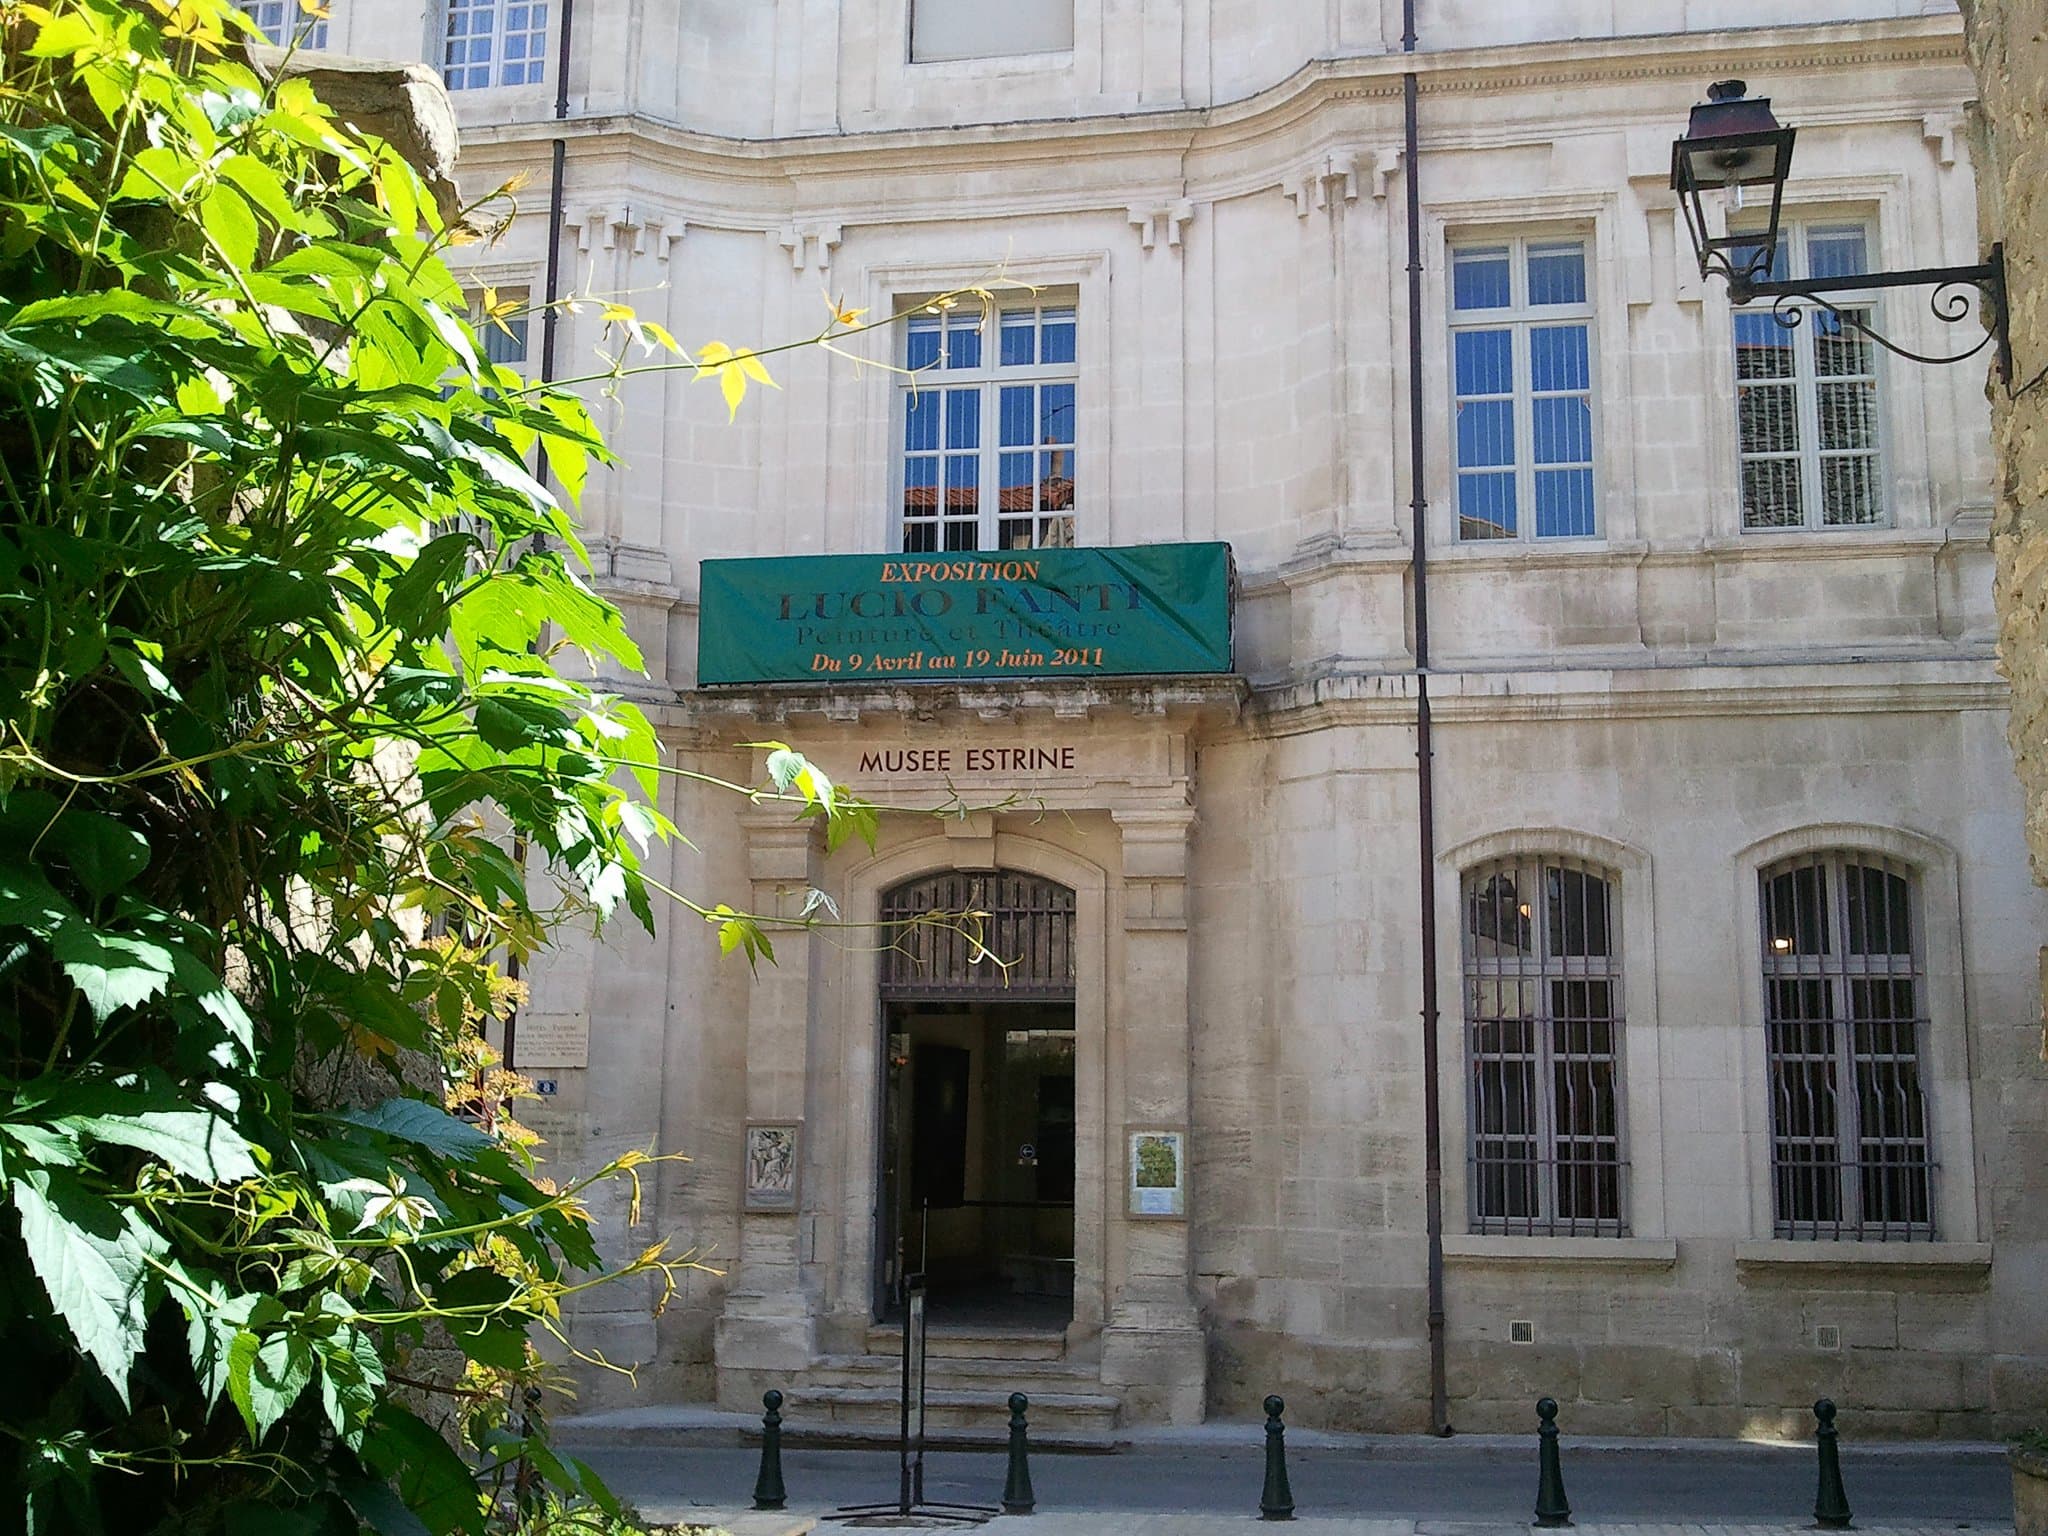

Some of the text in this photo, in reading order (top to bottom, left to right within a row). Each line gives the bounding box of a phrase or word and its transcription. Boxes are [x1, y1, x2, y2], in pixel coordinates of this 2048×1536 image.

[880, 560, 1041, 583] EXPOSITION
[776, 582, 1145, 621] LUCIO FANTI
[797, 625, 934, 646] Peinture
[949, 623, 977, 641] et
[811, 647, 1105, 673] Du 9 Avril au 19 Juin 2011
[859, 747, 1075, 772] MUSEE ESTRINE
